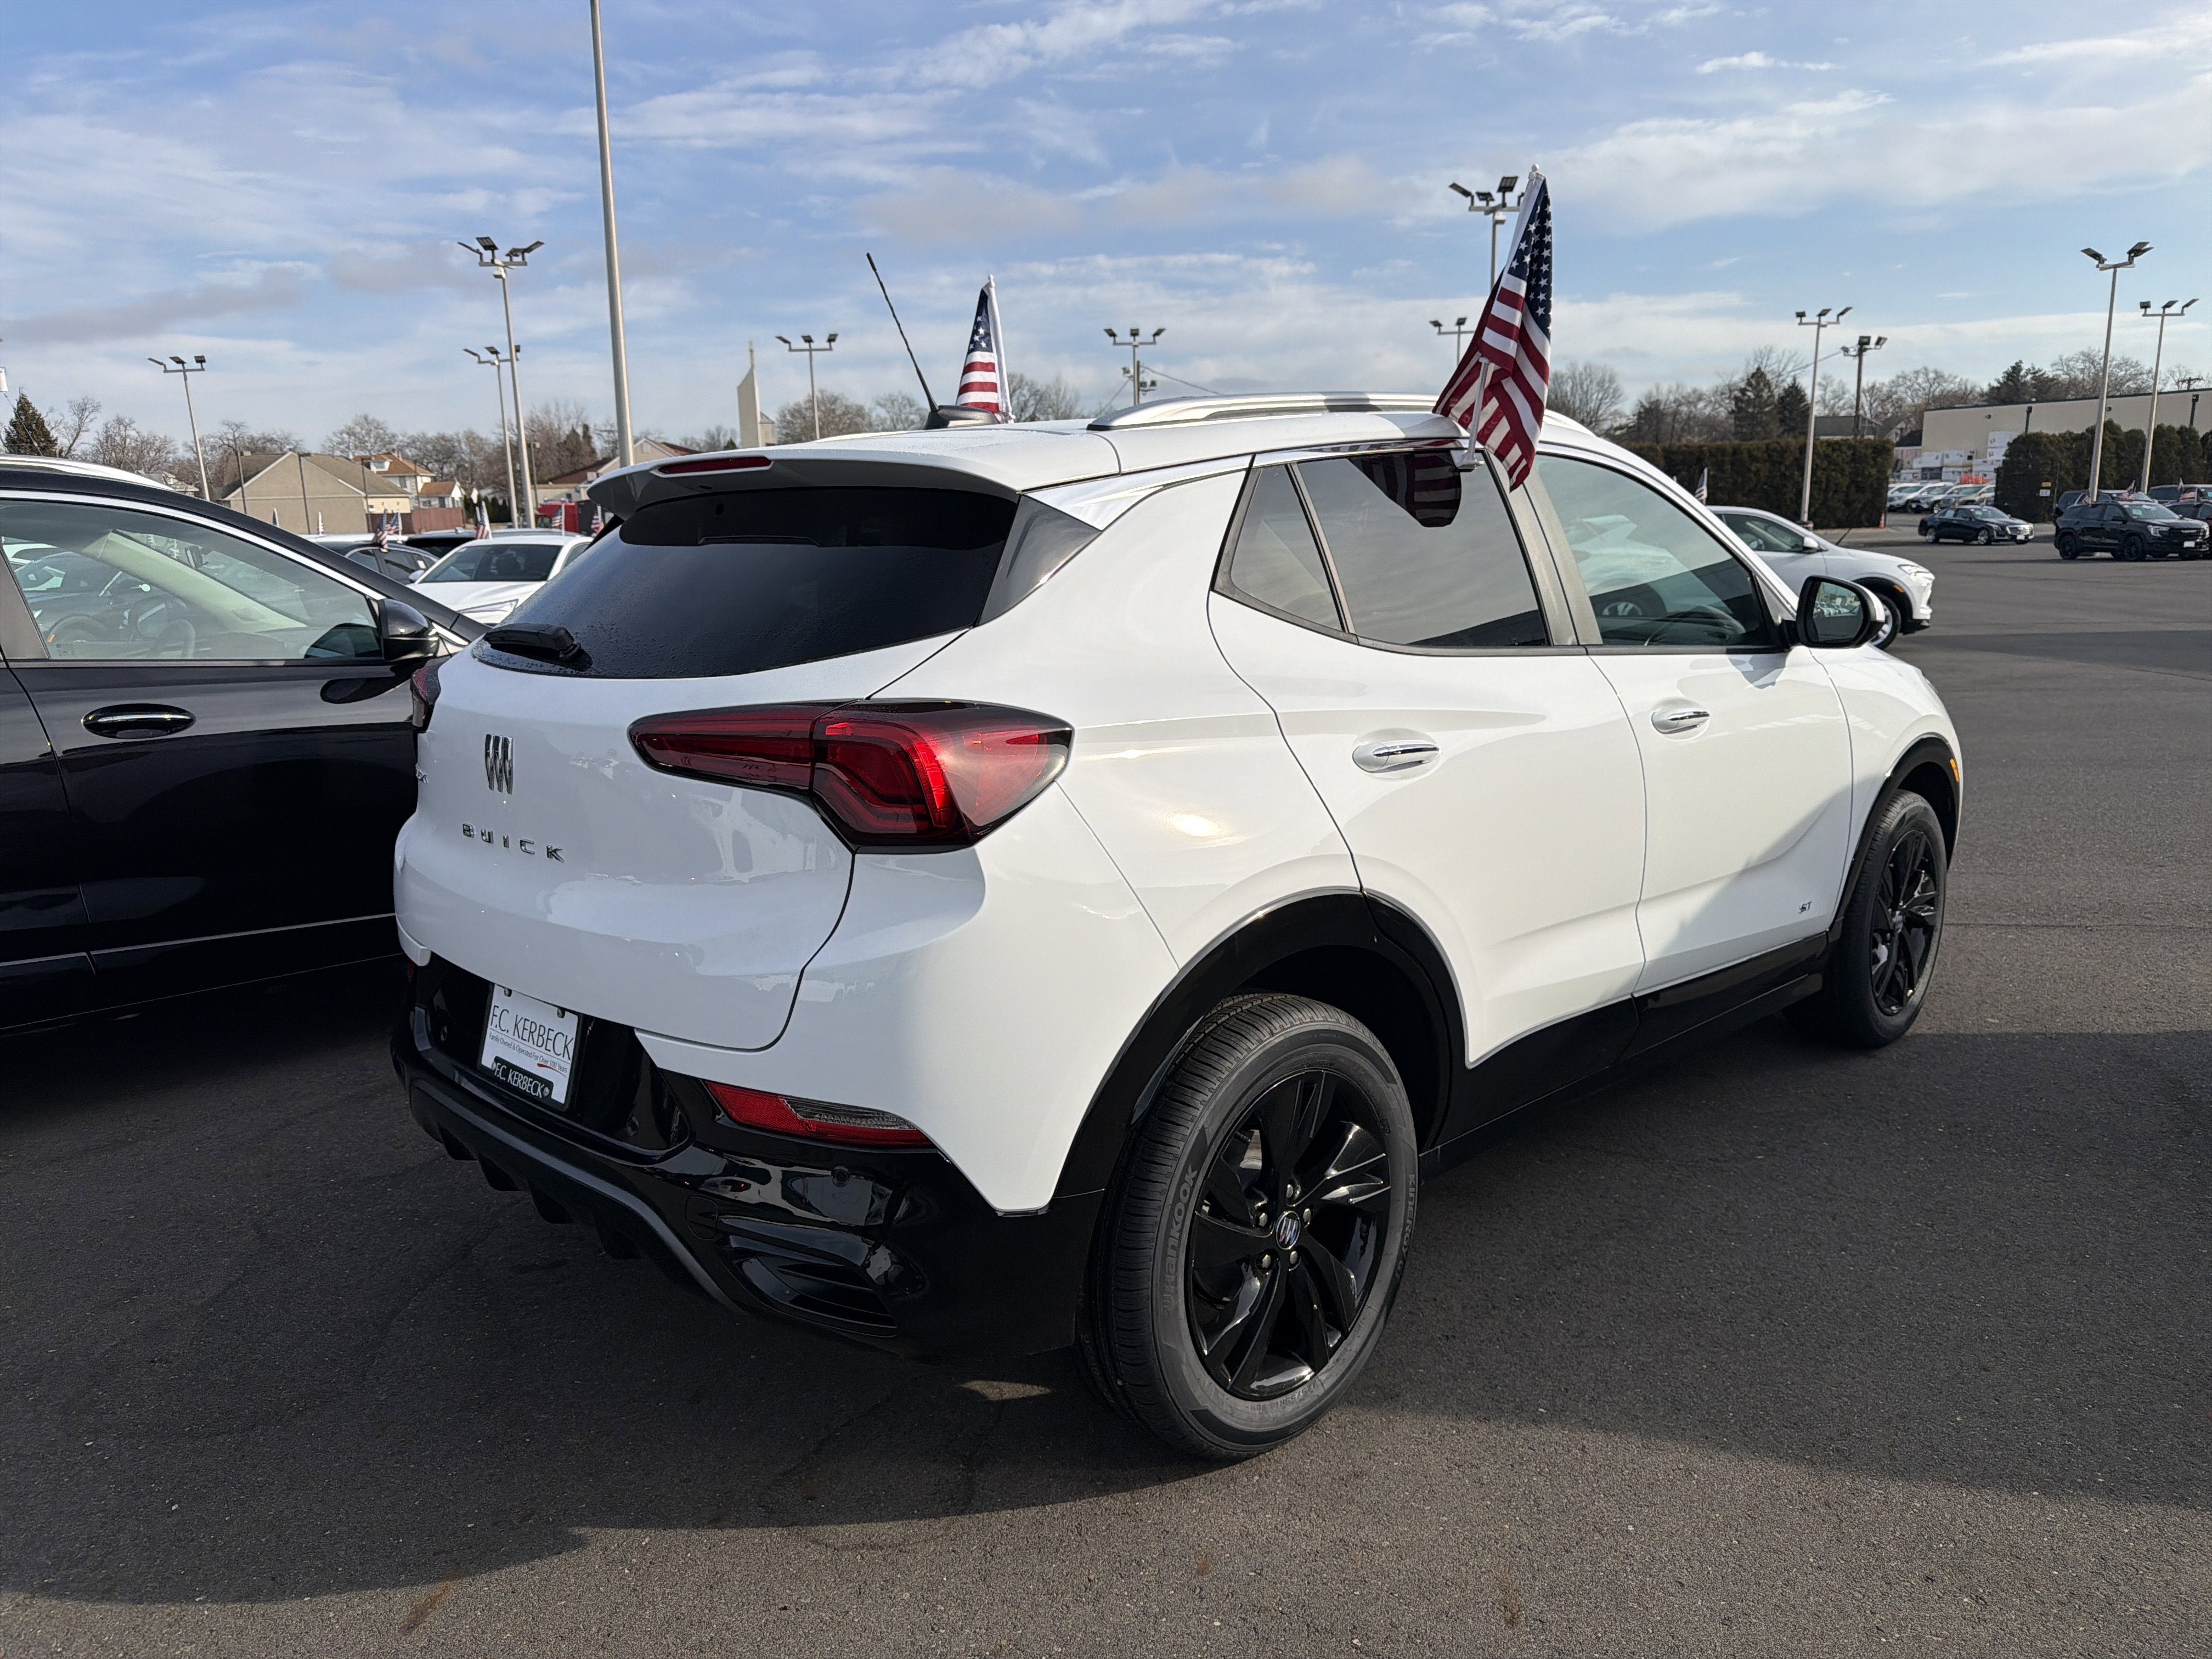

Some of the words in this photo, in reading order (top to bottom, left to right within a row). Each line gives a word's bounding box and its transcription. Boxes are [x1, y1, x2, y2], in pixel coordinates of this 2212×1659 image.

[462, 823, 565, 862] BUICK
[489, 1032, 500, 1043] Family
[500, 1037, 513, 1049] Owned
[516, 1045, 533, 1058] Operated
[539, 1055, 549, 1065] Over
[557, 1063, 568, 1074] Years
[490, 1005, 510, 1034] F.C.
[512, 1014, 574, 1061] KERBECK
[494, 1062, 507, 1081] F.C.
[507, 1069, 545, 1098] KERBECK
[1402, 1173, 1415, 1258] KINERGY
